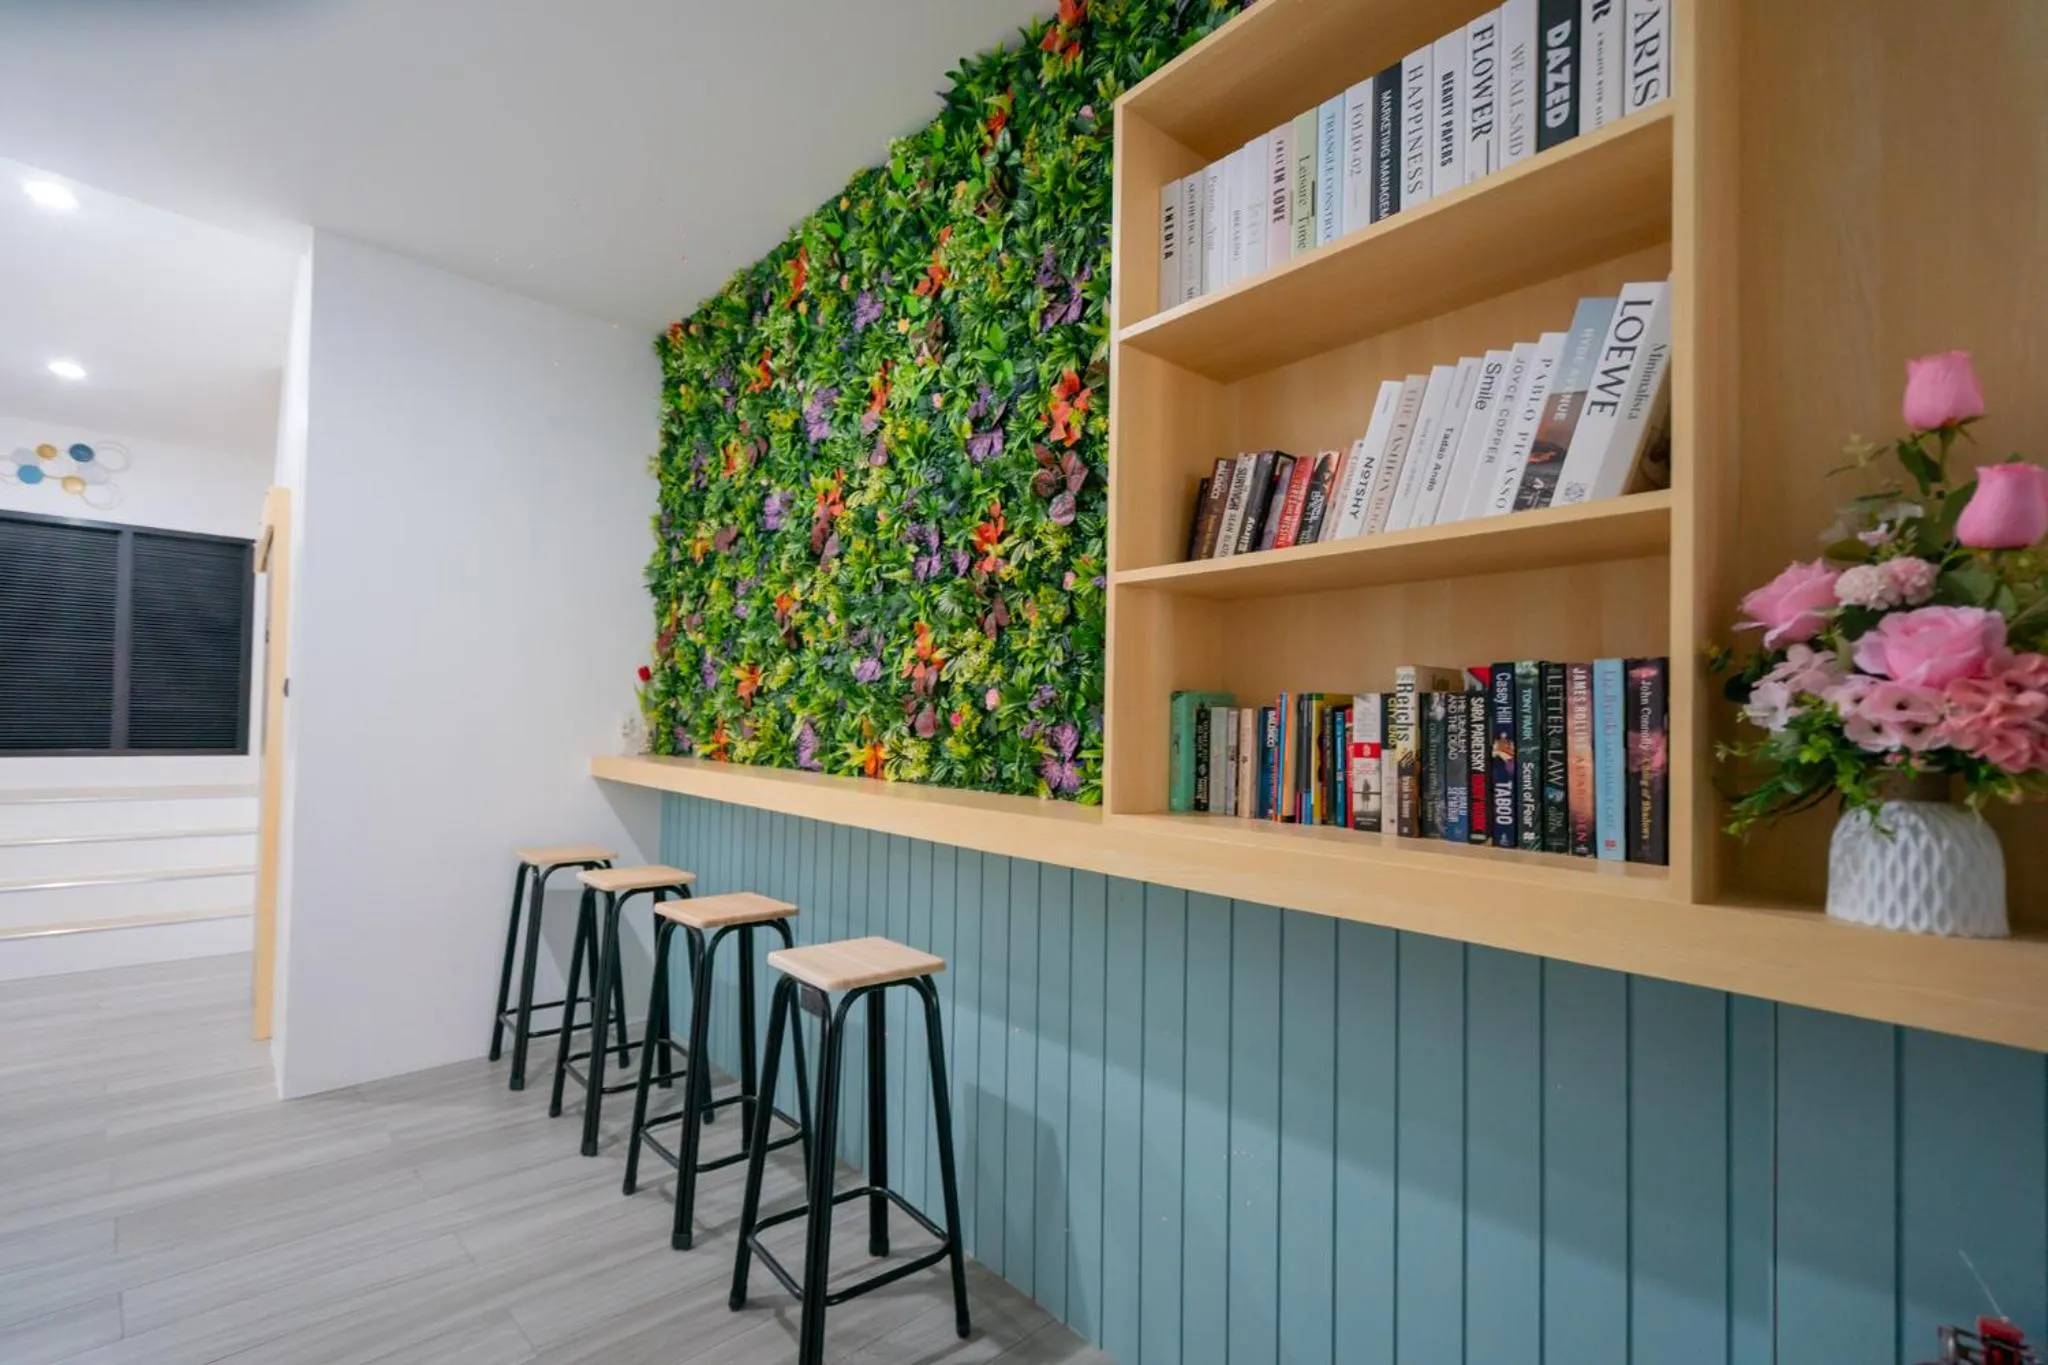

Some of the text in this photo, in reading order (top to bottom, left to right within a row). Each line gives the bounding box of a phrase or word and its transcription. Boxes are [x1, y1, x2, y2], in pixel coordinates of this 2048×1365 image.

[1471, 24, 1494, 142] FLOWER
[1546, 19, 1572, 129] DAZED
[1633, 0, 1661, 107] ARIS
[1325, 113, 1336, 175] TRIANGLE
[1380, 89, 1392, 157] MARKETING
[1408, 65, 1424, 195] HAPPINESS
[1440, 71, 1454, 167] BEAUTY PAPERS
[1272, 188, 1286, 225] LOVE
[1297, 154, 1311, 249] Leisure Time
[1476, 362, 1501, 410] Smile
[1588, 299, 1653, 417] LOEWE
[1627, 343, 1668, 421] Minimalista
[1485, 357, 1526, 465] JOYCE COPPER
[1495, 358, 1553, 510] PABLO PICASSO
[1349, 456, 1376, 520] NOTSHY
[1379, 424, 1407, 493] FASHION
[1426, 427, 1454, 493] Tadao Ando
[1396, 682, 1415, 742] Reichs
[1495, 672, 1512, 724] Casey Hill
[1522, 688, 1533, 741] TONY PARK
[1547, 677, 1564, 737] LETTER
[1573, 667, 1586, 702] JAMES
[1639, 679, 1652, 705] John
[1448, 694, 1458, 760] AND THE DEAD
[1470, 697, 1485, 772] SARA PARETSKY
[1639, 707, 1652, 750] Connolly
[1522, 762, 1536, 828] Scent of Fear
[1548, 749, 1565, 786] LAW
[1448, 786, 1459, 822] SEYMOUR
[1495, 781, 1513, 825] TABOO
